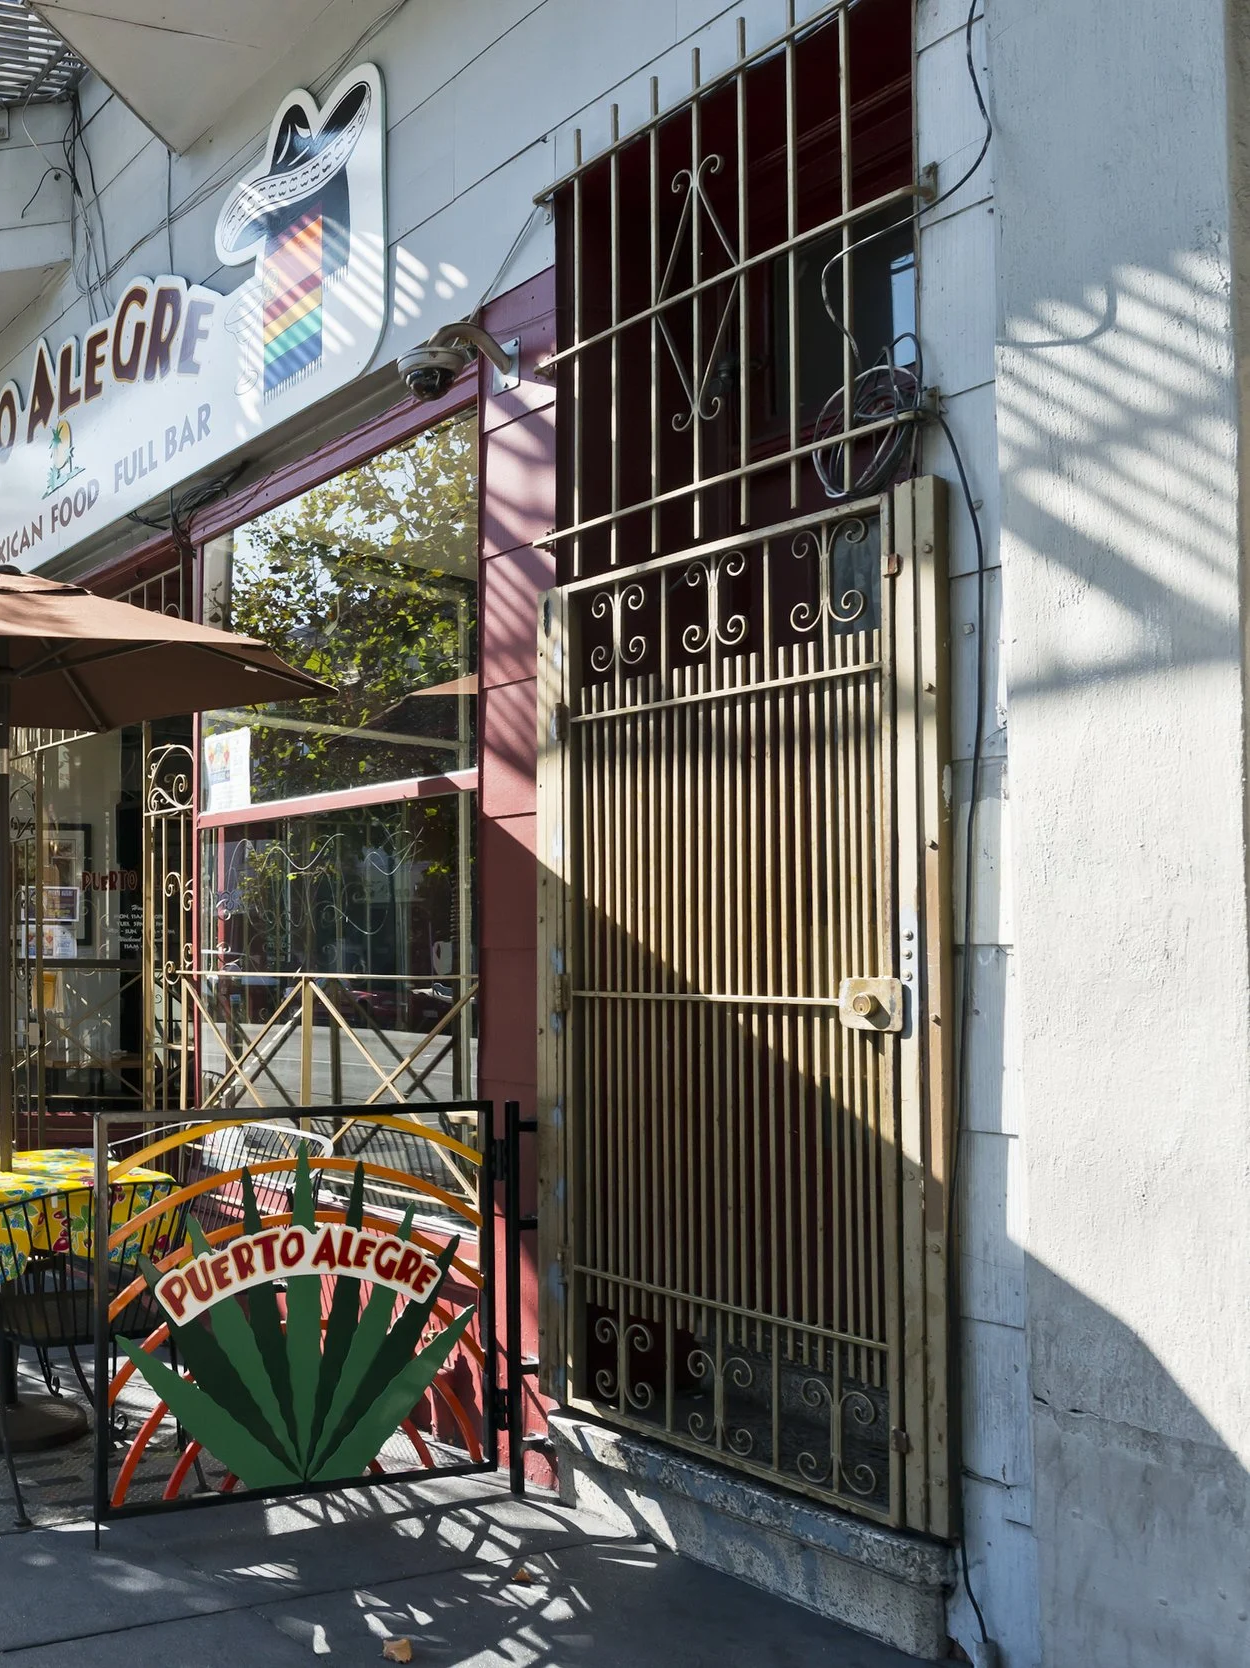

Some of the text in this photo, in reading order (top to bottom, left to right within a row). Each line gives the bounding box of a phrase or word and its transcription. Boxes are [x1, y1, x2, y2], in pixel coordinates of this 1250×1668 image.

[26, 285, 215, 444] ALEGRE
[50, 478, 100, 534] FOOD
[113, 440, 159, 494] FULL
[164, 403, 212, 456] BAR
[81, 870, 137, 891] PUERTO
[160, 1228, 438, 1318] PUERTO ALEGRE
